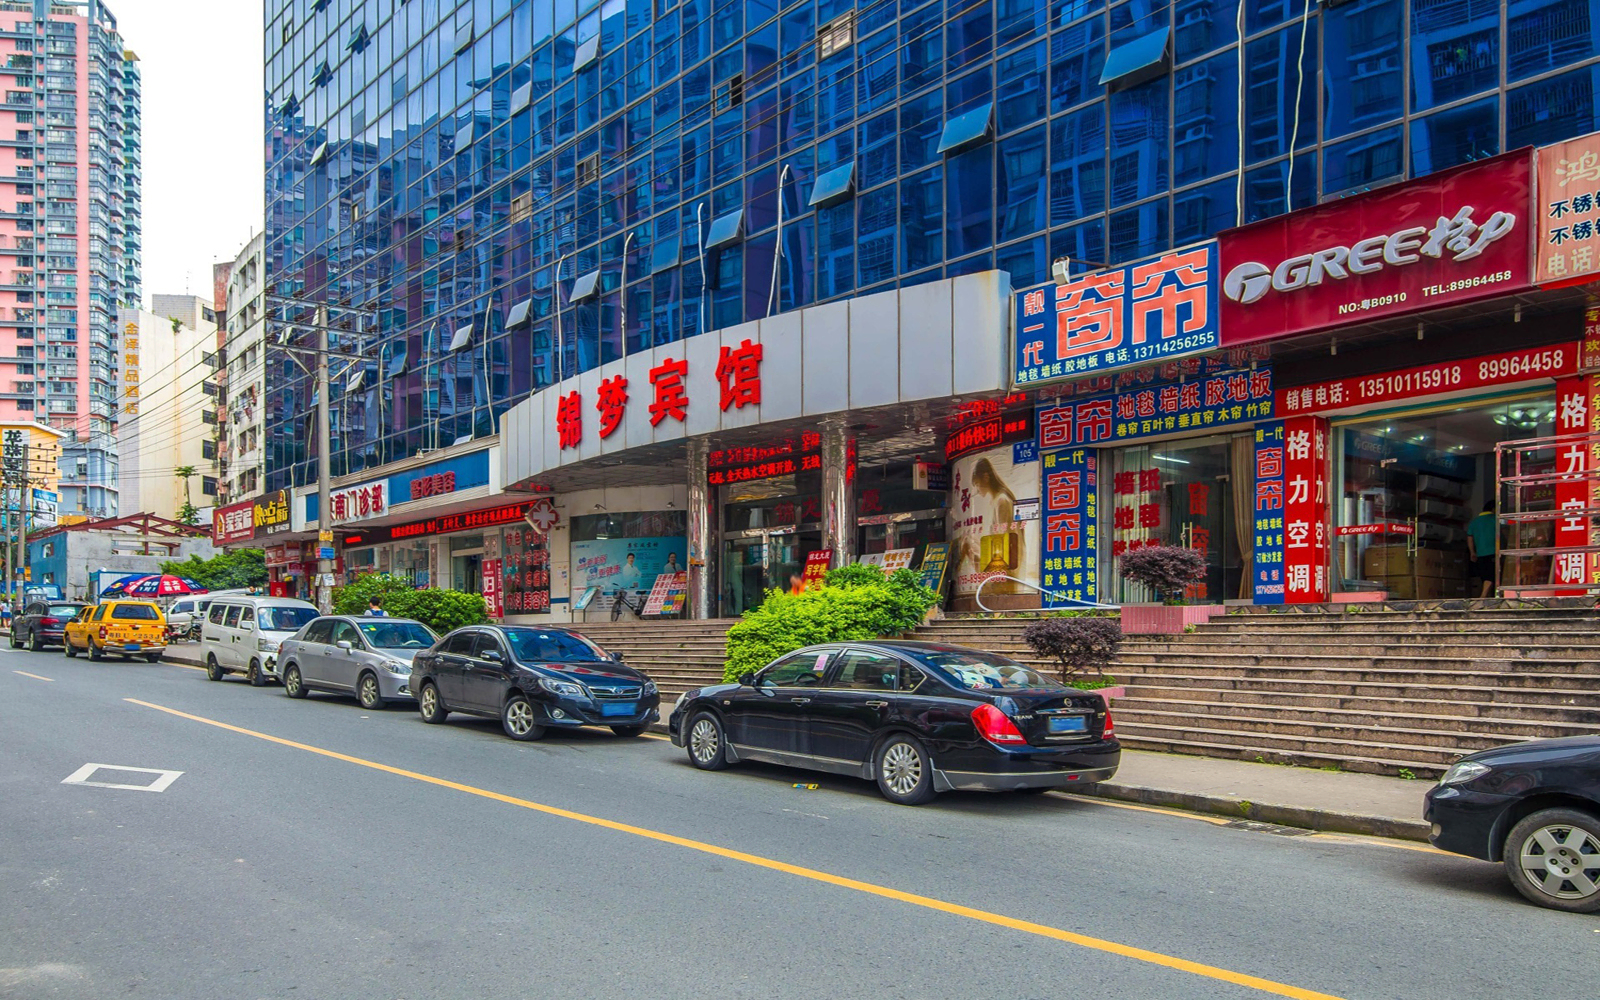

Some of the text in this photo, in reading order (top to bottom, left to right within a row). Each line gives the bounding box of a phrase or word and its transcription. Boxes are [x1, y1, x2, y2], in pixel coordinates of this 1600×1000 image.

[1549, 190, 1600, 219] 不锈
[1549, 218, 1600, 245] 不锈
[1272, 227, 1426, 292] GREE
[1056, 247, 1209, 360] 窗帘
[1338, 270, 1512, 315] NO:粤B0910 TEL:89964458
[1018, 366, 1039, 382] 地毯
[1041, 361, 1062, 378] 墙纸
[1065, 354, 1099, 373] 胶地板
[1134, 331, 1215, 360] 13714256255
[1023, 289, 1045, 367] 靓一代
[556, 338, 763, 450] 锦梦宾馆
[1039, 400, 1113, 448] 窗帘
[1116, 390, 1155, 421] 地毯
[1159, 382, 1201, 414] 墙纸
[1205, 369, 1273, 407] 胶地板
[1285, 349, 1564, 411] 销售电话: 13510115918 89964458
[1142, 415, 1176, 434] 百叶帘
[1178, 408, 1216, 428] 垂直帘
[1217, 404, 1244, 422] 木帘
[1246, 400, 1273, 418] 竹帘
[1255, 427, 1283, 443] 靓一代
[1044, 450, 1084, 468] 靓一代
[1256, 447, 1283, 510] 窗帘
[1559, 392, 1588, 585] 格力空调
[331, 484, 384, 520] 南门诊部
[1047, 471, 1081, 552] 窗帘
[1287, 430, 1311, 593] 格力空调
[1314, 429, 1324, 594] 格力空调
[1044, 572, 1083, 586] 胶地板
